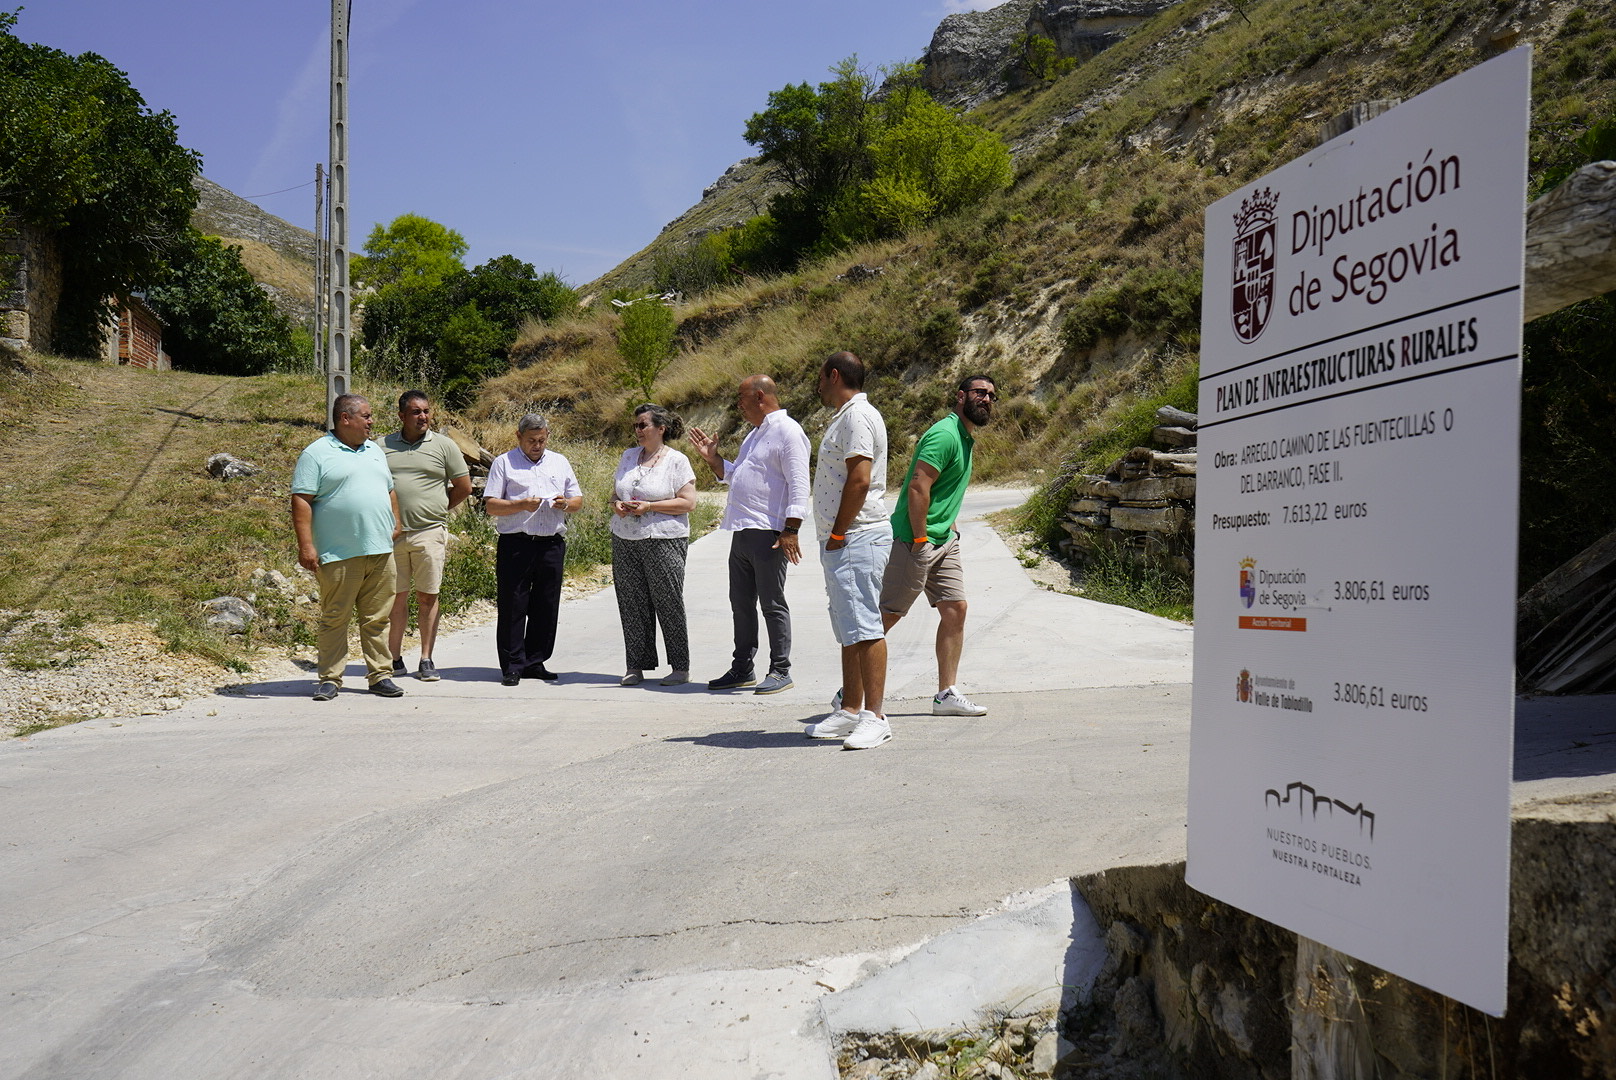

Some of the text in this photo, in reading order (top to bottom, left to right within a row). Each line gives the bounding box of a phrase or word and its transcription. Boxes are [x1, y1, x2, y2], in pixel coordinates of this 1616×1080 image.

[1291, 148, 1461, 257] Diputación
[1288, 223, 1461, 317] de Segovia
[1217, 317, 1478, 412] PLAN DE INFRAESTRUCTURAS RURALES
[1214, 408, 1453, 469] Obra: ARREGLO CAMINO DE LAS FUENTECILLAS O
[1240, 461, 1343, 494] DEL BARRANCO, FASE II.
[1212, 501, 1367, 532] Presupuesto: 7.613,22 euros
[1259, 568, 1306, 588] Diputación
[1334, 581, 1430, 602] 3.806,61 euros
[1259, 589, 1306, 609] de Segovia
[1289, 679, 1295, 689] de
[1333, 682, 1428, 712] 3.806,61 euros
[1255, 693, 1271, 707] Valle
[1272, 696, 1279, 708] de
[1267, 827, 1317, 853] NUESTROS
[1273, 849, 1361, 887] NUESTRA FORTALEZA
